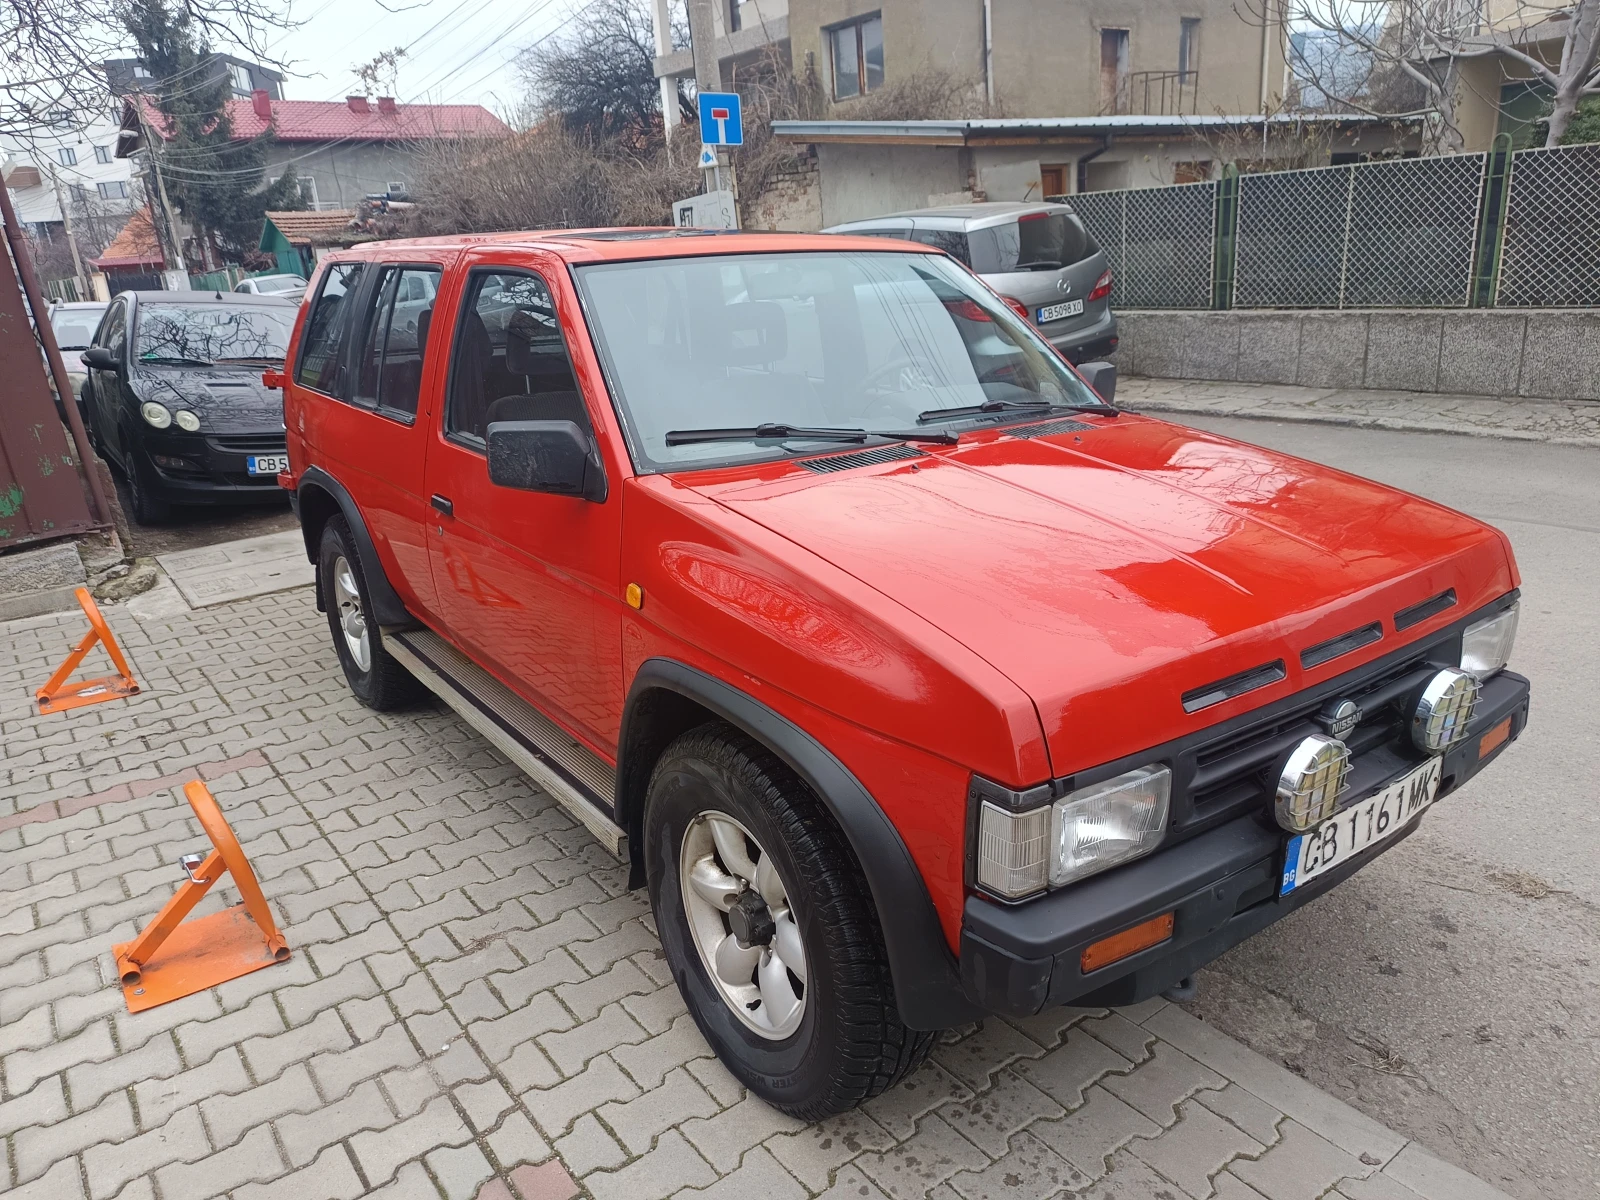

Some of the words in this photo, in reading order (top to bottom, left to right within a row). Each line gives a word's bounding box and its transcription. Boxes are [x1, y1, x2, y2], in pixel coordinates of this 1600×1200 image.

[1043, 308, 1053, 320] CB
[1054, 303, 1072, 317] 5098
[1073, 301, 1082, 313] XO
[258, 458, 277, 471] CB
[1332, 710, 1363, 735] NISSAN
[1303, 821, 1338, 875] CB
[1350, 784, 1404, 850] 1161
[1407, 763, 1437, 815] MK
[1283, 869, 1297, 886] BG
